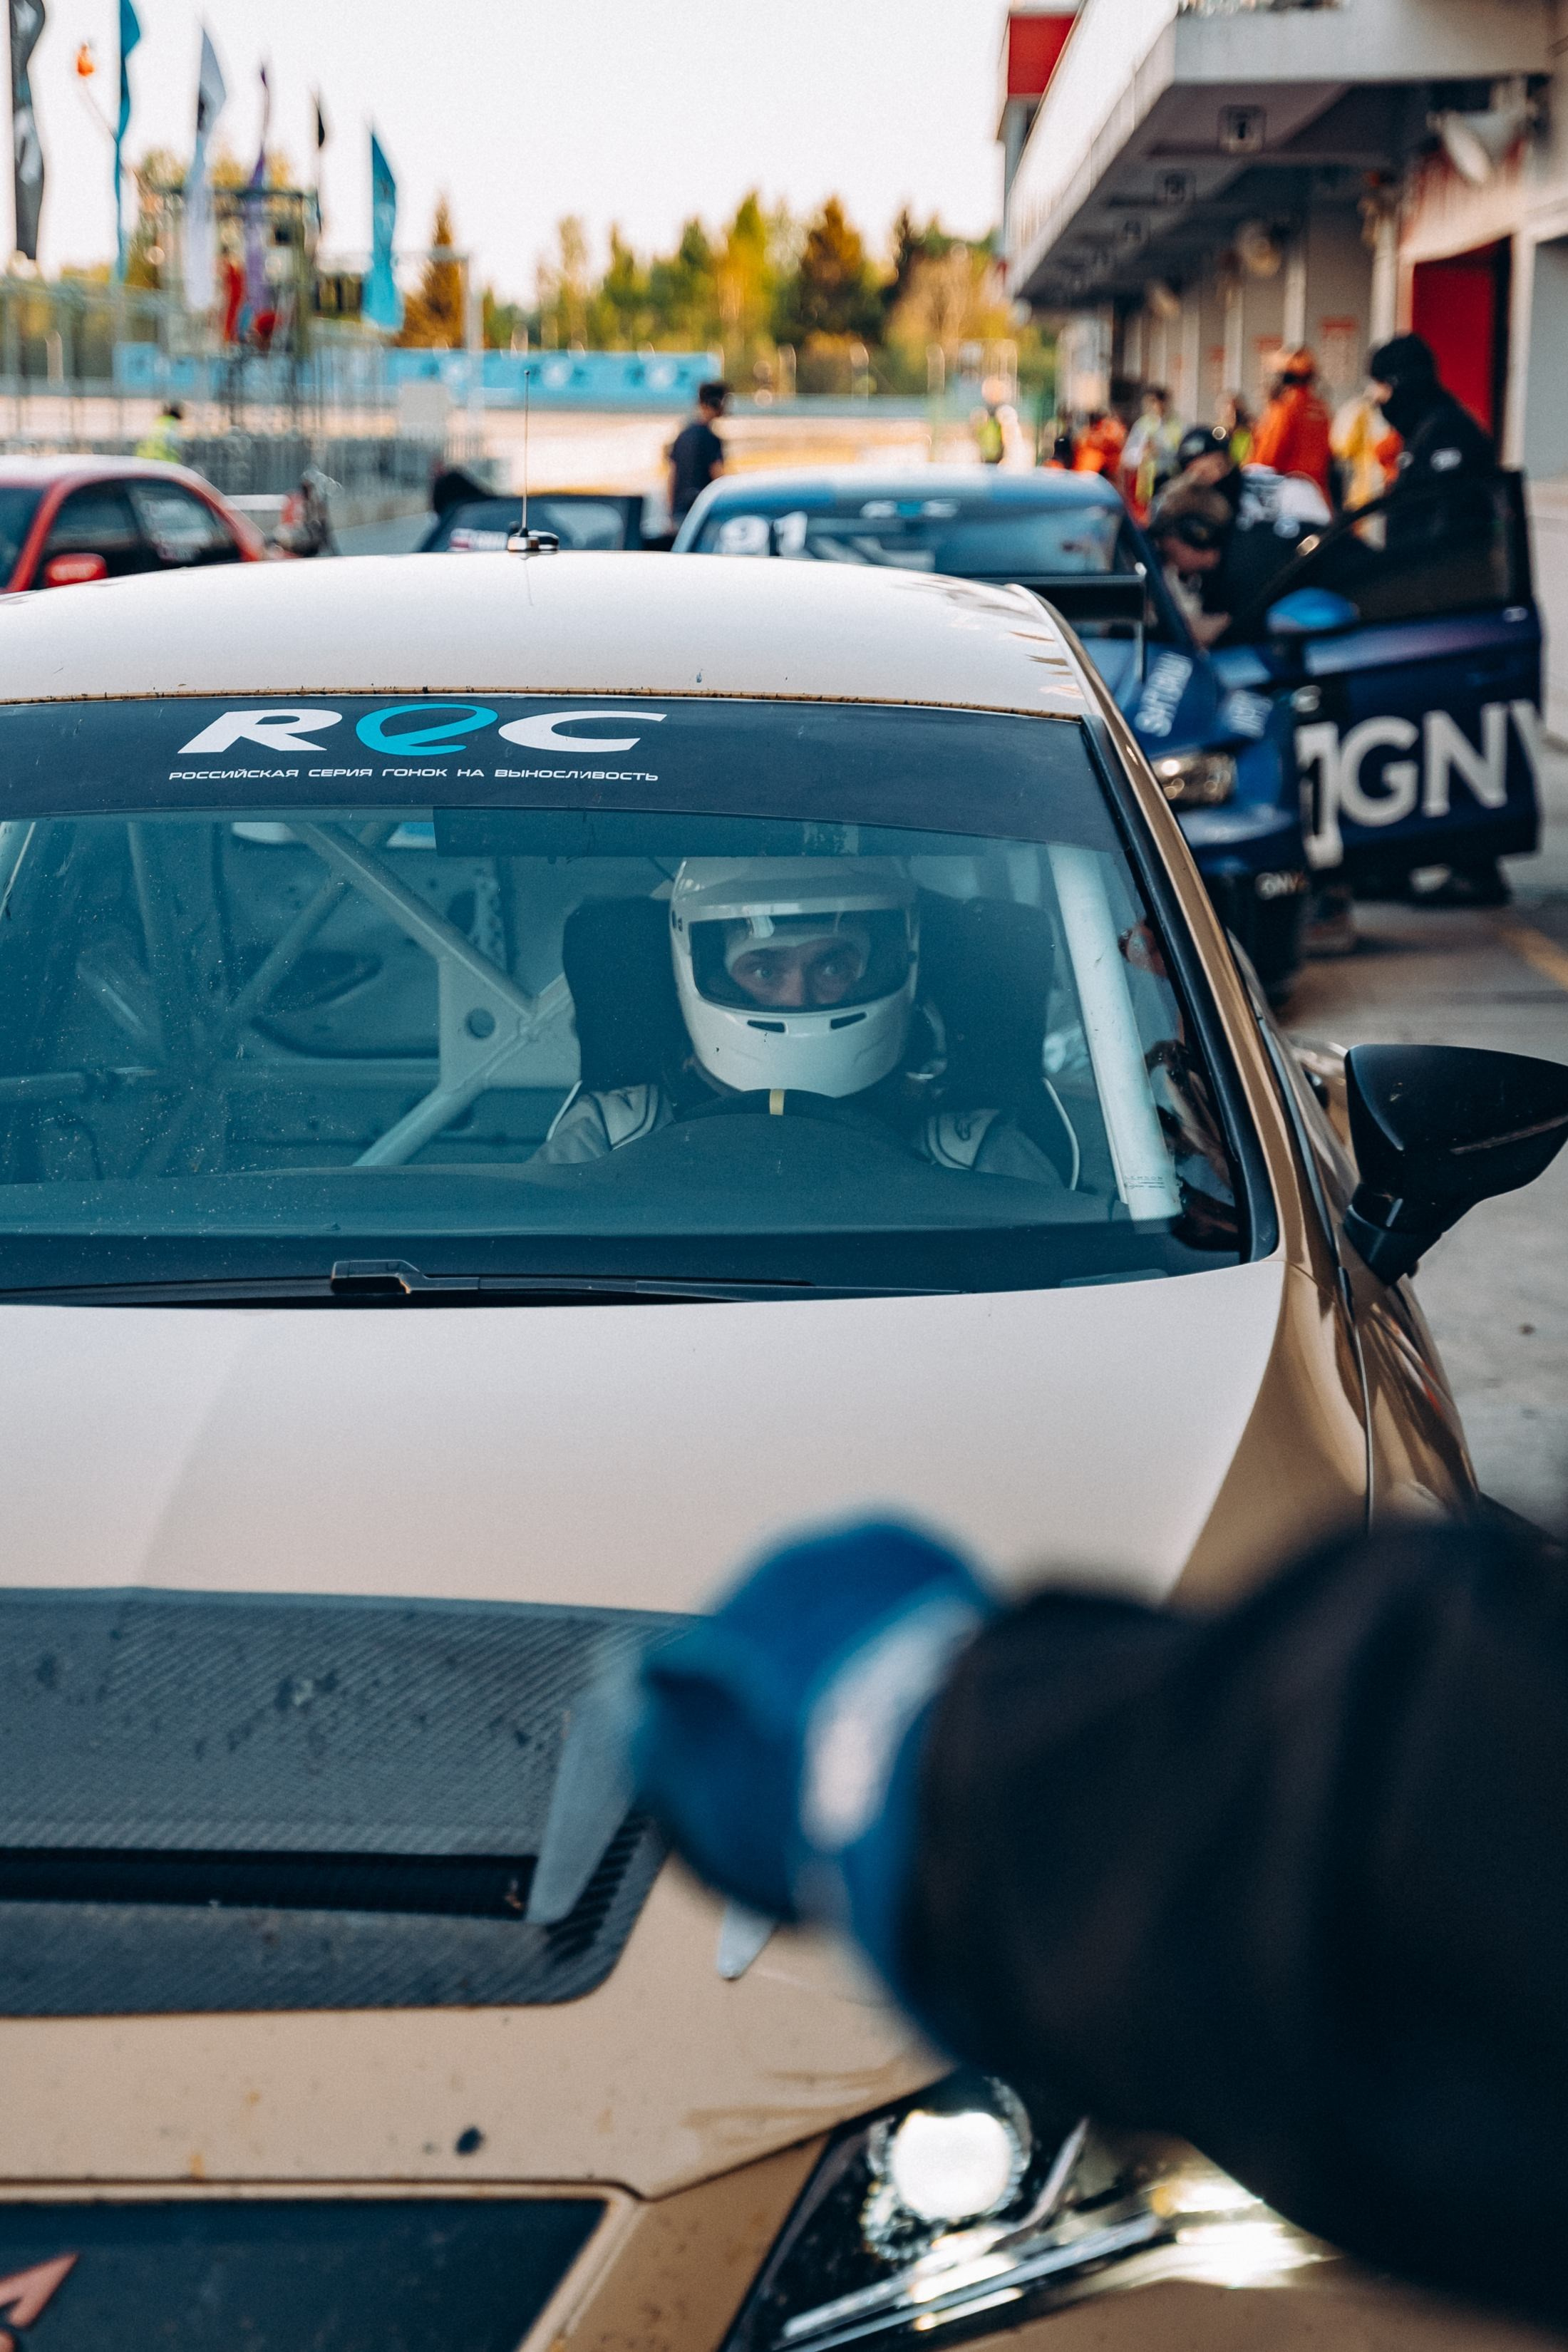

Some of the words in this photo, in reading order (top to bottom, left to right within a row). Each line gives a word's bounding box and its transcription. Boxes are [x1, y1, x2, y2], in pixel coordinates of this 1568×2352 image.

[169, 768, 299, 780] РОССИЙСКАЯ
[307, 768, 373, 777] СЕРИЯ
[382, 768, 448, 777] ГОНОК
[456, 768, 485, 777] НА
[494, 768, 659, 781] ВЫНОСЛИВОСТЬ
